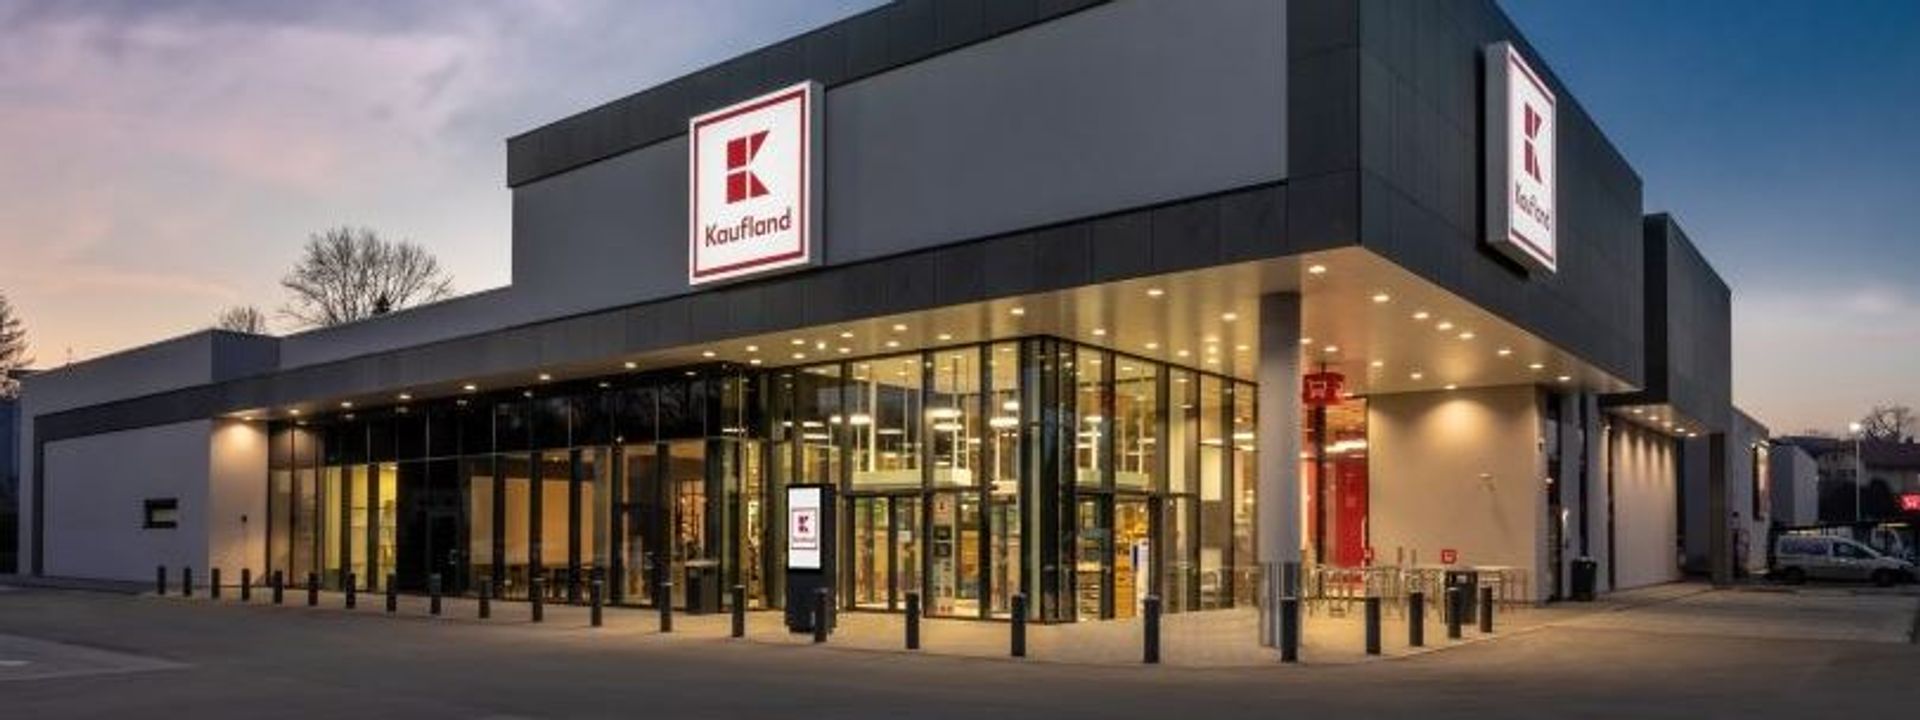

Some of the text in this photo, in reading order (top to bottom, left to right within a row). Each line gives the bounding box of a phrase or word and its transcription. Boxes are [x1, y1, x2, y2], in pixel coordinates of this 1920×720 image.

[727, 130, 770, 204] K
[1524, 102, 1542, 183] K
[705, 207, 791, 247] Kaufland
